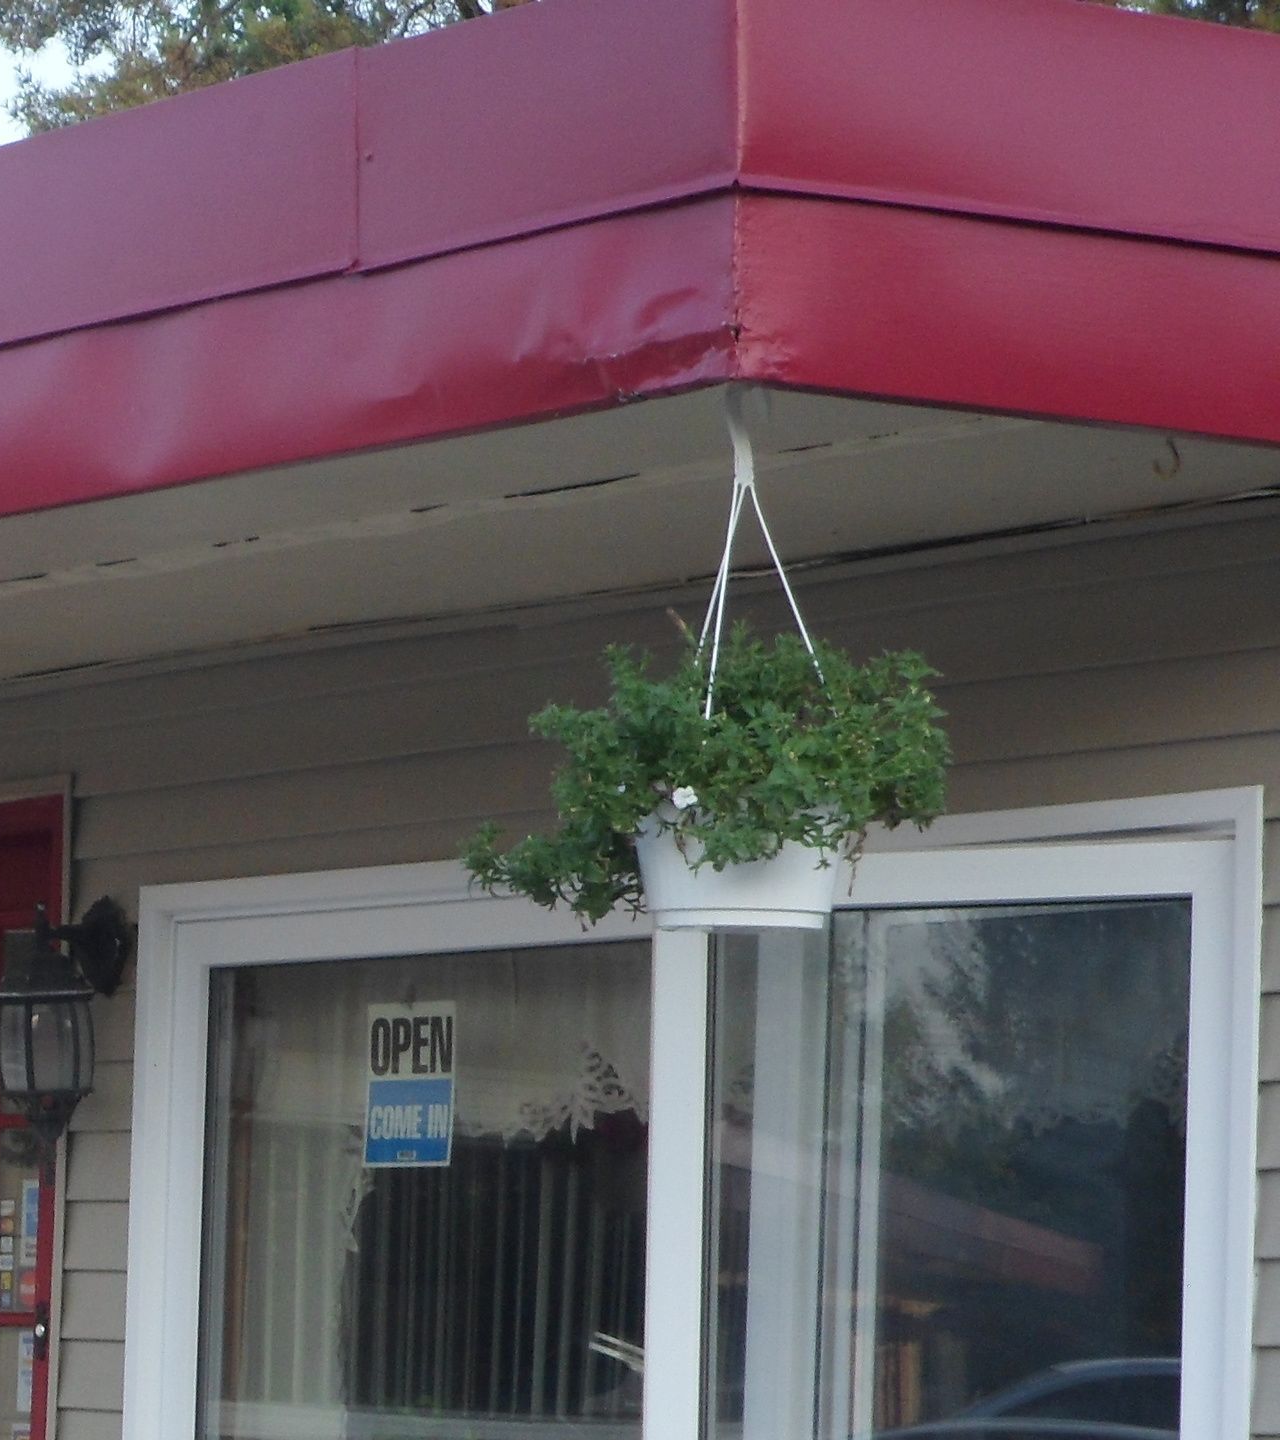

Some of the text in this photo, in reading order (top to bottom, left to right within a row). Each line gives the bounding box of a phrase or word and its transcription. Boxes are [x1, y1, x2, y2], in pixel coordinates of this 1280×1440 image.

[370, 1016, 453, 1076] OPEN
[370, 1104, 449, 1140] COME IN
